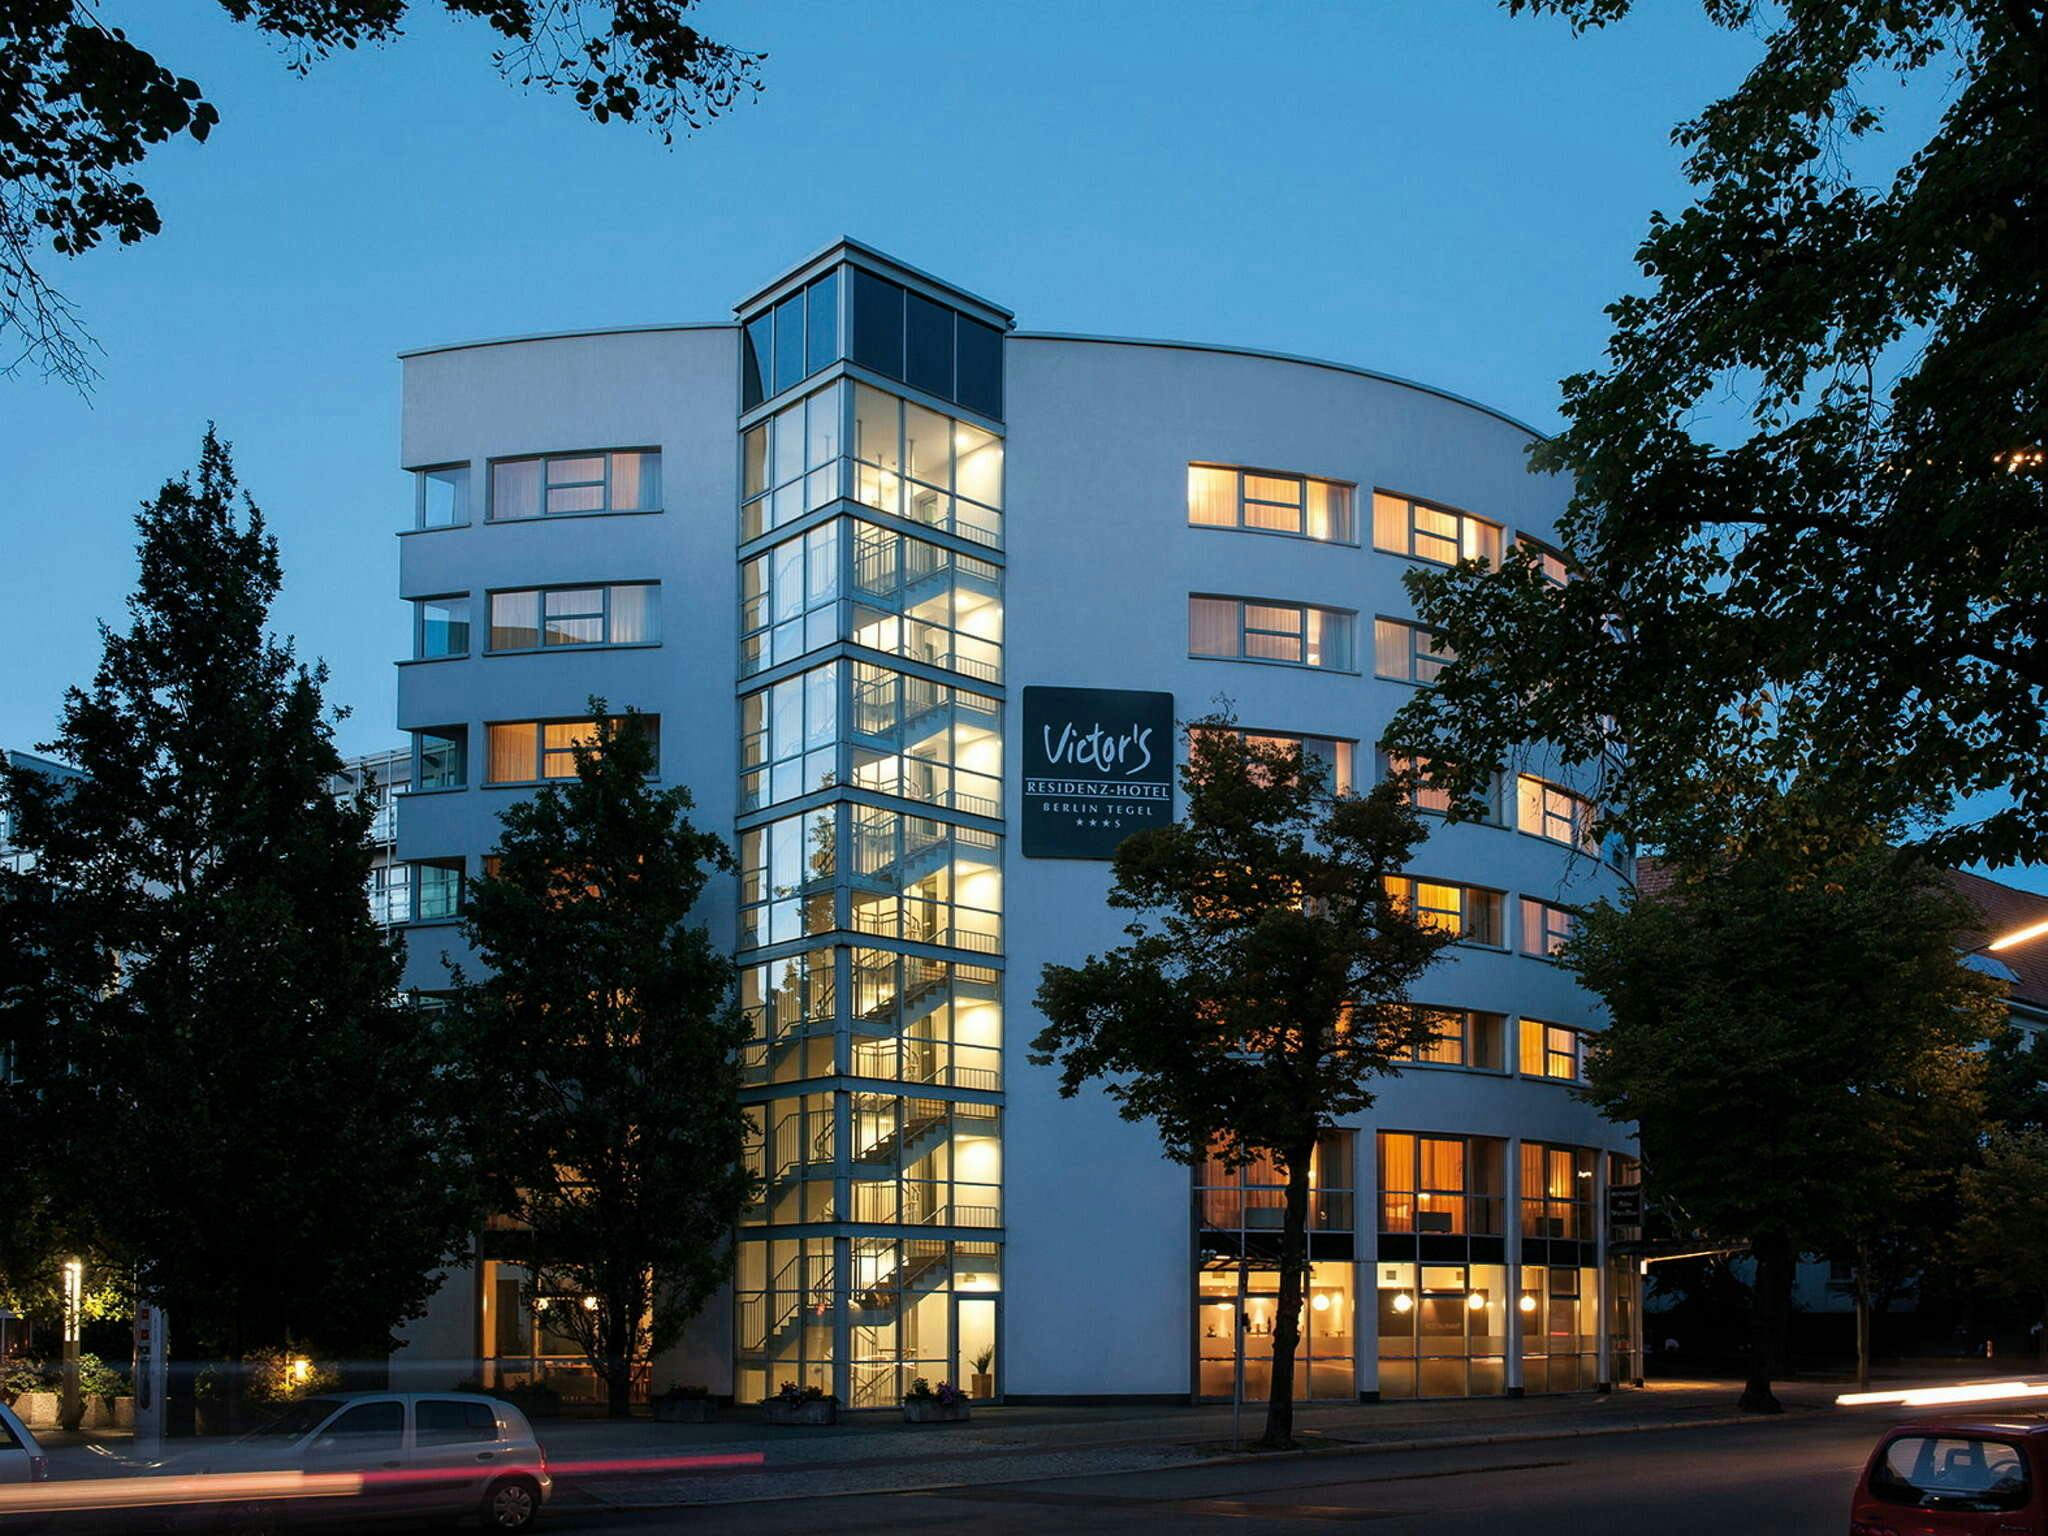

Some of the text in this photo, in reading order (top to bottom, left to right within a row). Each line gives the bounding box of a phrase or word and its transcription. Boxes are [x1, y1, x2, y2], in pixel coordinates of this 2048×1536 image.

[1043, 721, 1152, 776] Victor's
[1027, 781, 1169, 798] RESIDENZ-HOTEL
[1042, 802, 1153, 816] BERLIN TEGEL
